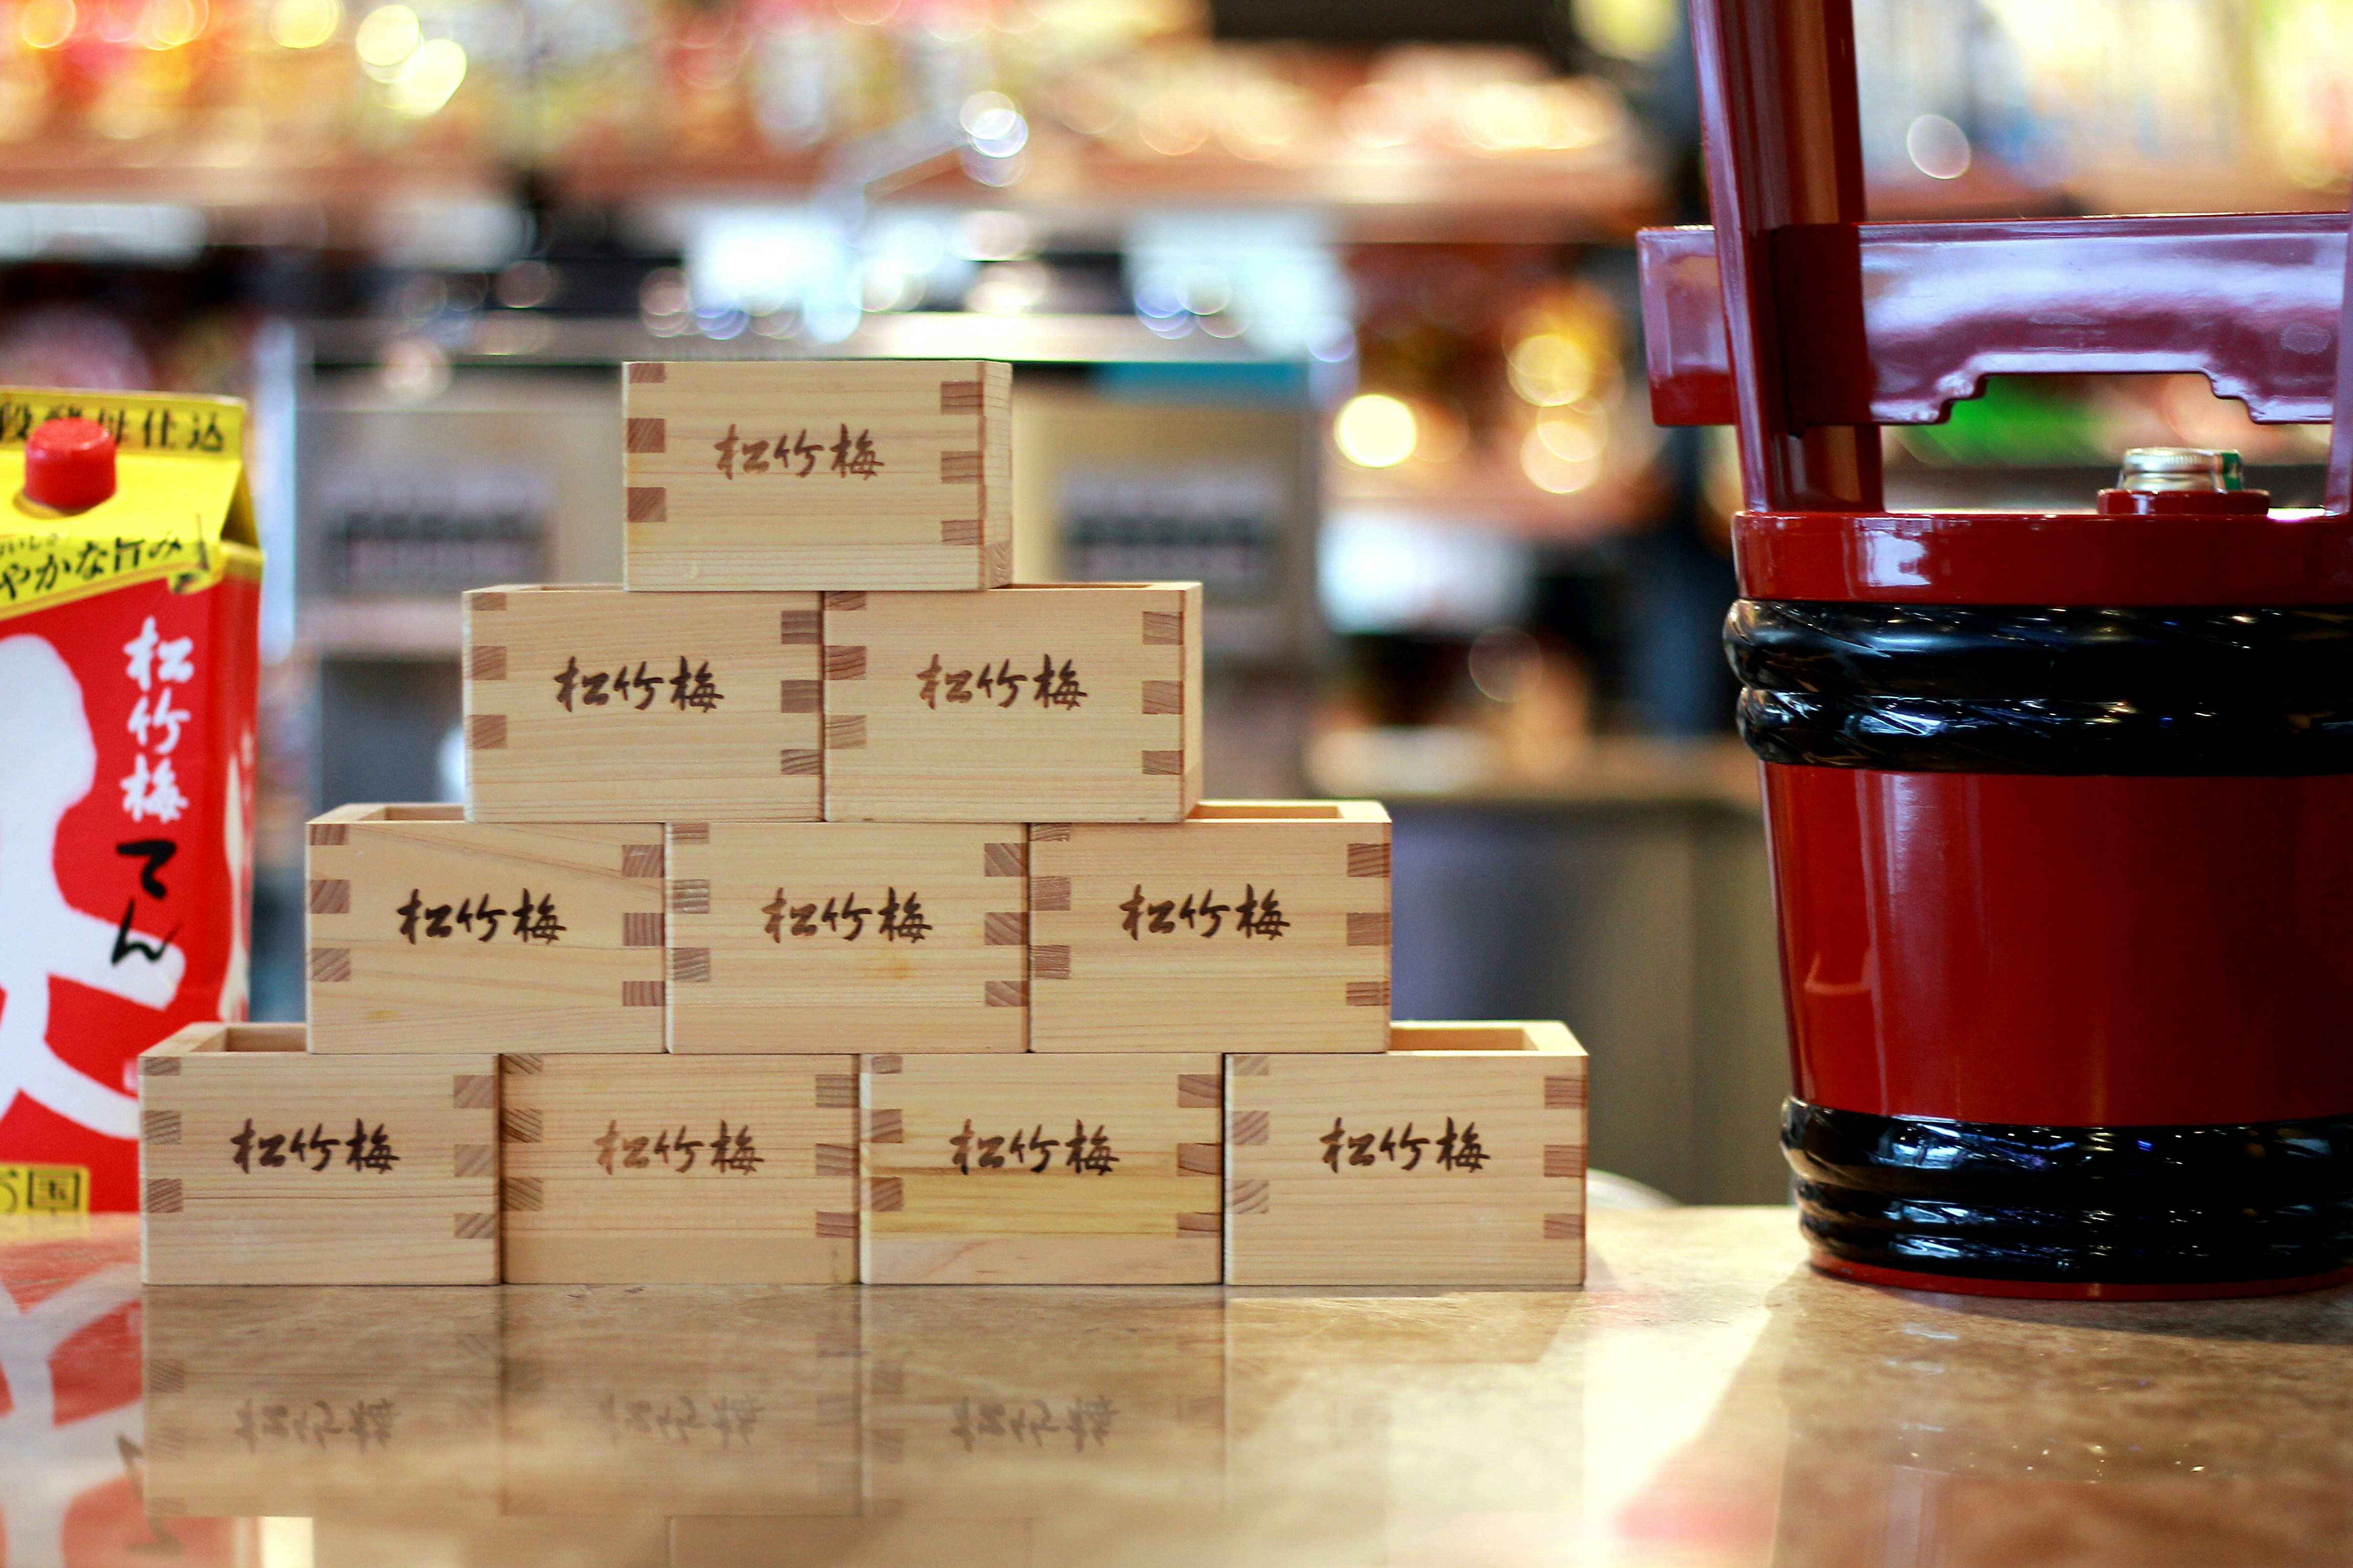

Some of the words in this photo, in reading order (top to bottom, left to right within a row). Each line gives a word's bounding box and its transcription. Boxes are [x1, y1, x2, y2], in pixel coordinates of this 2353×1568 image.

[715, 424, 884, 479] 松竹梅
[554, 656, 724, 713] 松竹梅
[918, 654, 1087, 710] 松竹梅
[120, 616, 193, 824] 松竹梅
[111, 839, 184, 965] てん
[396, 889, 566, 944] 松竹梅
[763, 887, 932, 943] 松竹梅
[1120, 884, 1290, 940] 松竹梅
[231, 1119, 400, 1174] 松竹梅
[596, 1120, 765, 1176] 松竹梅
[949, 1120, 1119, 1176] 松竹梅
[1320, 1117, 1490, 1173] 松竹梅
